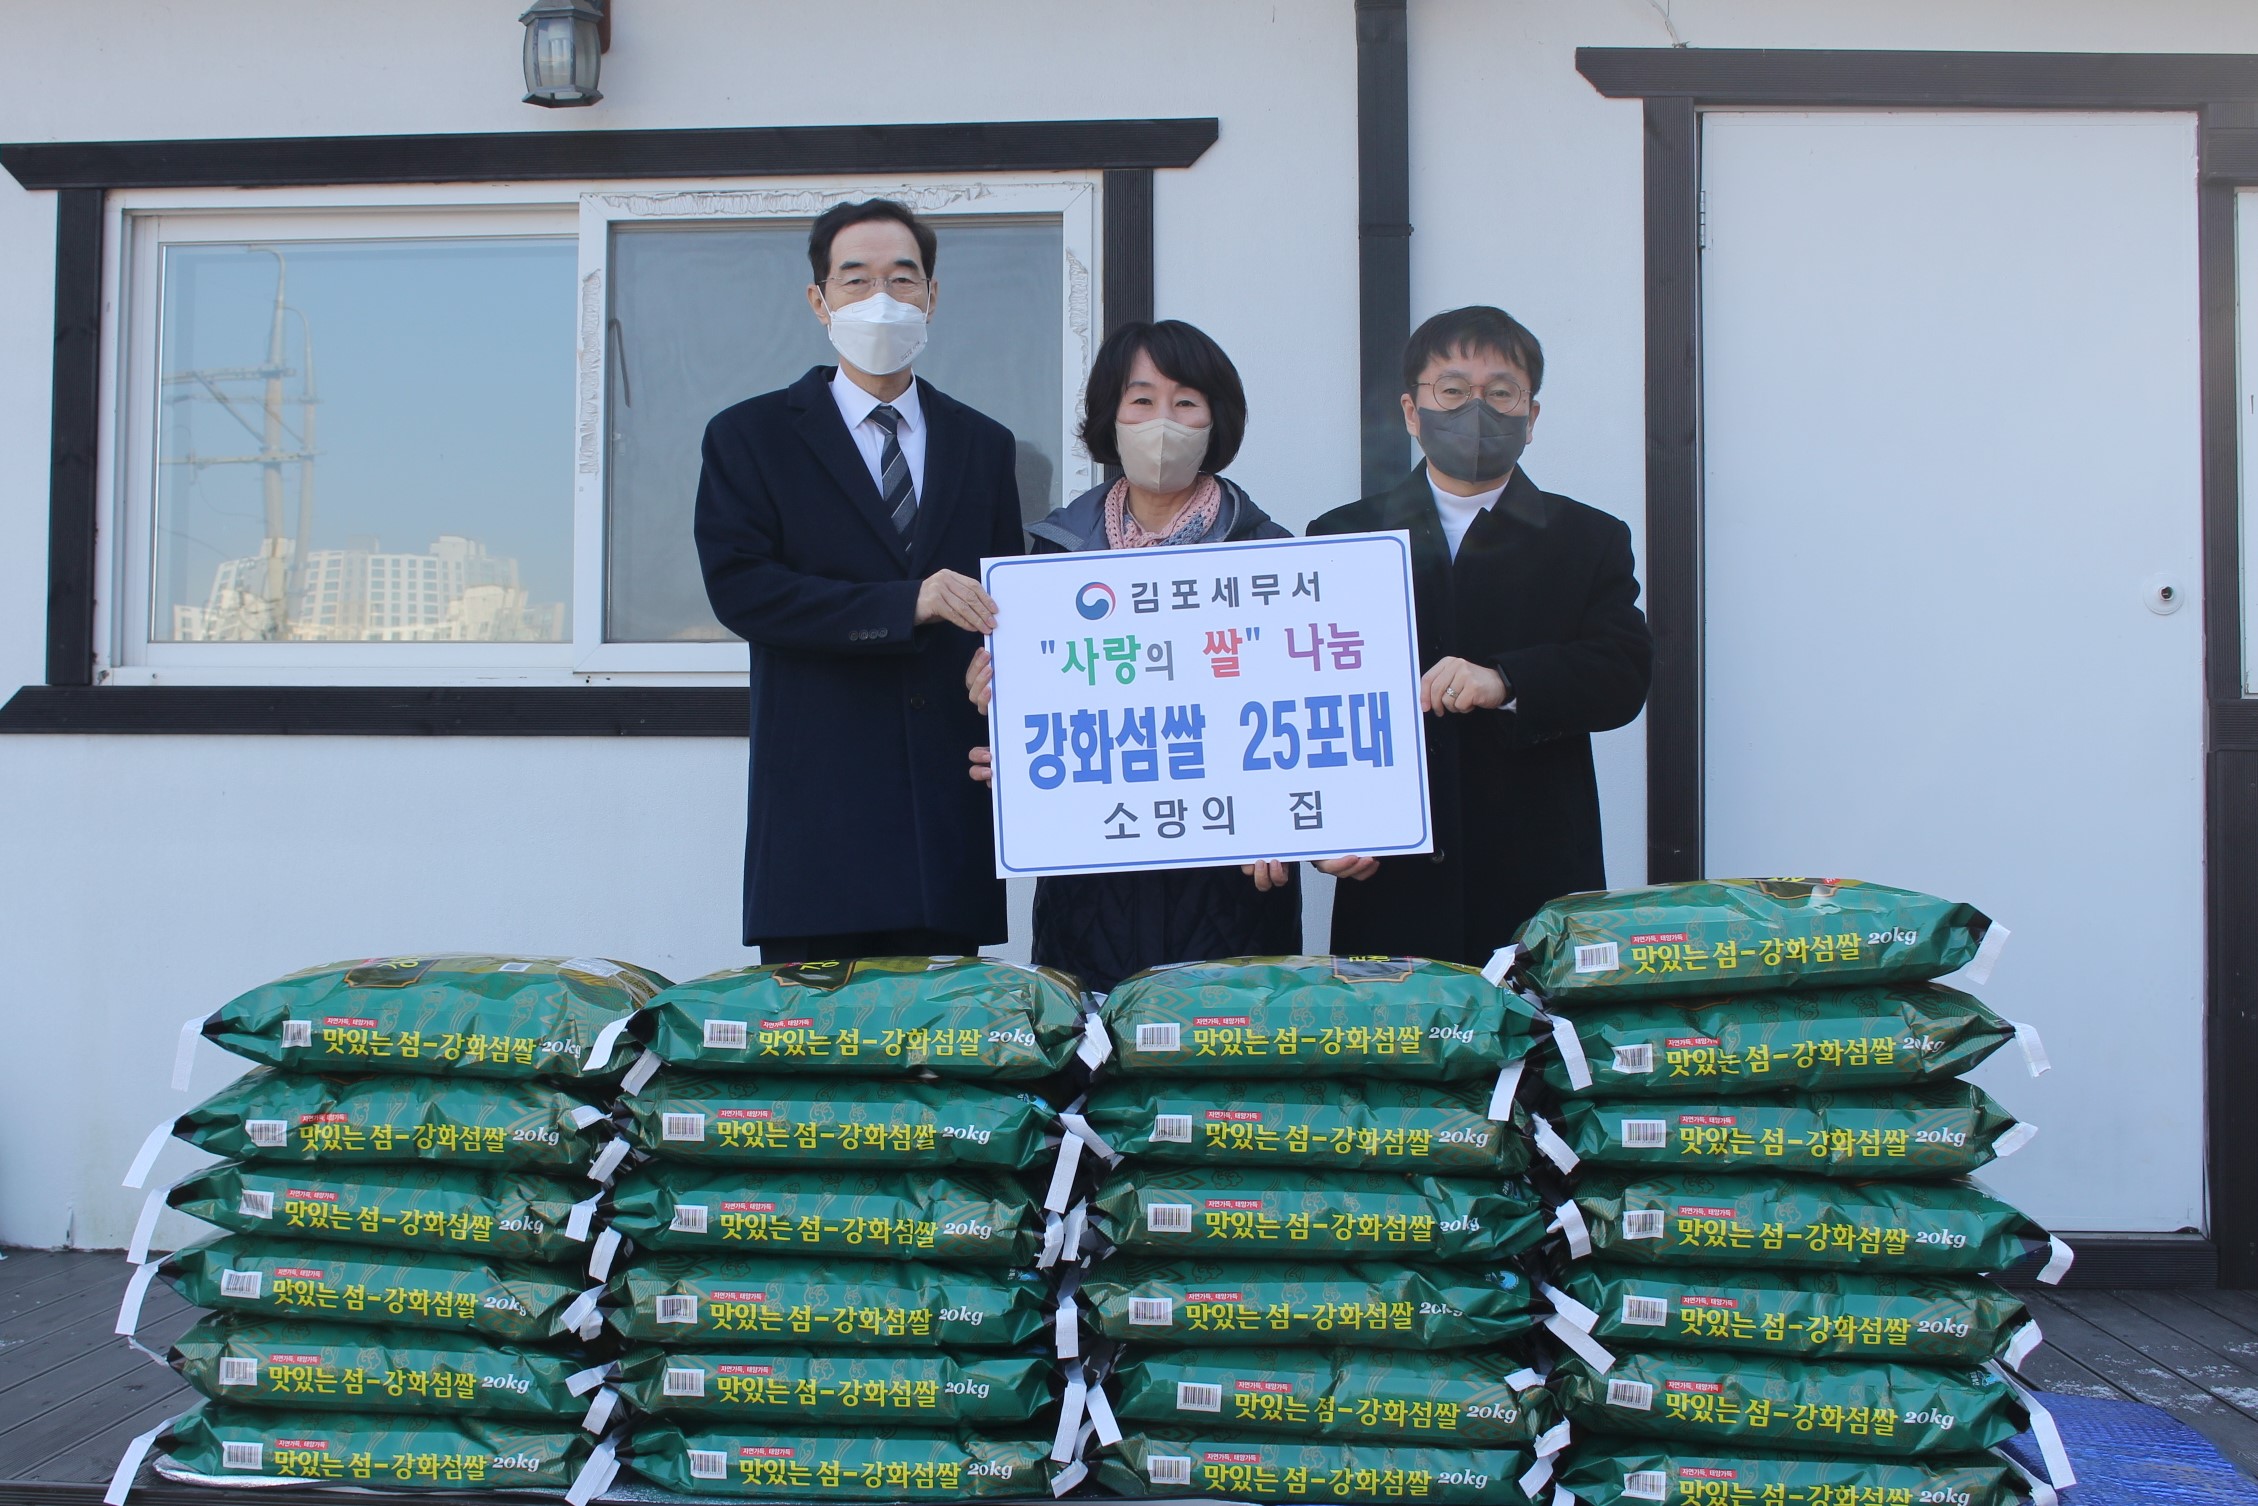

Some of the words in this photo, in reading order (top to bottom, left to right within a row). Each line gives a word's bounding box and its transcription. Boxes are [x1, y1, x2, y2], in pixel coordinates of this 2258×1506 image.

[1131, 571, 1321, 614] 김포세무서
[1040, 634, 1175, 686] "사랑의
[1203, 626, 1261, 678] 쌀"
[1285, 623, 1365, 672] 나눔
[1024, 703, 1206, 790] 강화섬쌀
[1239, 691, 1394, 771] 25포대
[1103, 794, 1236, 840] 소망의
[1289, 790, 1324, 830] 집
[1632, 945, 1708, 974] 맛있는
[1868, 927, 1917, 945] 20kg
[323, 1028, 391, 1056] 맛있는
[542, 1039, 581, 1058] 20kg
[760, 1029, 831, 1056] 맛있는
[988, 1028, 1035, 1046] 20kg
[1193, 1028, 1269, 1056] 맛있는
[1428, 1024, 1474, 1043] 20kg
[1666, 1048, 1740, 1077] 맛있는
[300, 1124, 365, 1151] 맛있는
[513, 1127, 559, 1145] 20kg
[717, 1120, 789, 1148] 맛있는
[942, 1126, 991, 1144] 20kg
[1205, 1122, 1280, 1150] 맛있는
[1438, 1128, 1489, 1147] 20kg
[1680, 1126, 1755, 1154] 맛있는
[1916, 1127, 1966, 1147] 20kg
[285, 1201, 352, 1229] 맛있는
[499, 1217, 544, 1234] 20kg
[720, 1213, 793, 1240] 맛있는
[944, 1221, 992, 1239] 20kg
[1205, 1211, 1281, 1239] 맛있는
[1440, 1215, 1479, 1232] 20kg
[1678, 1219, 1754, 1248] 맛있는
[1916, 1229, 1966, 1248] 20kg
[273, 1280, 339, 1308] 맛있는
[710, 1303, 783, 1331] 맛있는
[939, 1306, 983, 1326] 20kg
[1185, 1302, 1261, 1330] 맛있는
[1680, 1308, 1756, 1338] 맛있는
[1917, 1318, 1968, 1337] 20kg
[269, 1366, 337, 1393] 맛있는
[482, 1374, 529, 1393] 20kg
[717, 1376, 790, 1404] 맛있는
[945, 1379, 989, 1399] 20kg
[1235, 1393, 1310, 1422] 맛있는
[1466, 1404, 1518, 1423] 20kg
[1665, 1393, 1740, 1423] 맛있는
[1904, 1408, 1954, 1429] 20kg
[274, 1450, 344, 1478] 맛있는
[492, 1454, 539, 1473] 20kg
[739, 1458, 812, 1486] 맛있는
[967, 1460, 1012, 1479] 20kg
[1204, 1464, 1278, 1491] 맛있는
[1438, 1470, 1487, 1488] 20kg
[1920, 1488, 1970, 1506] 20kg
